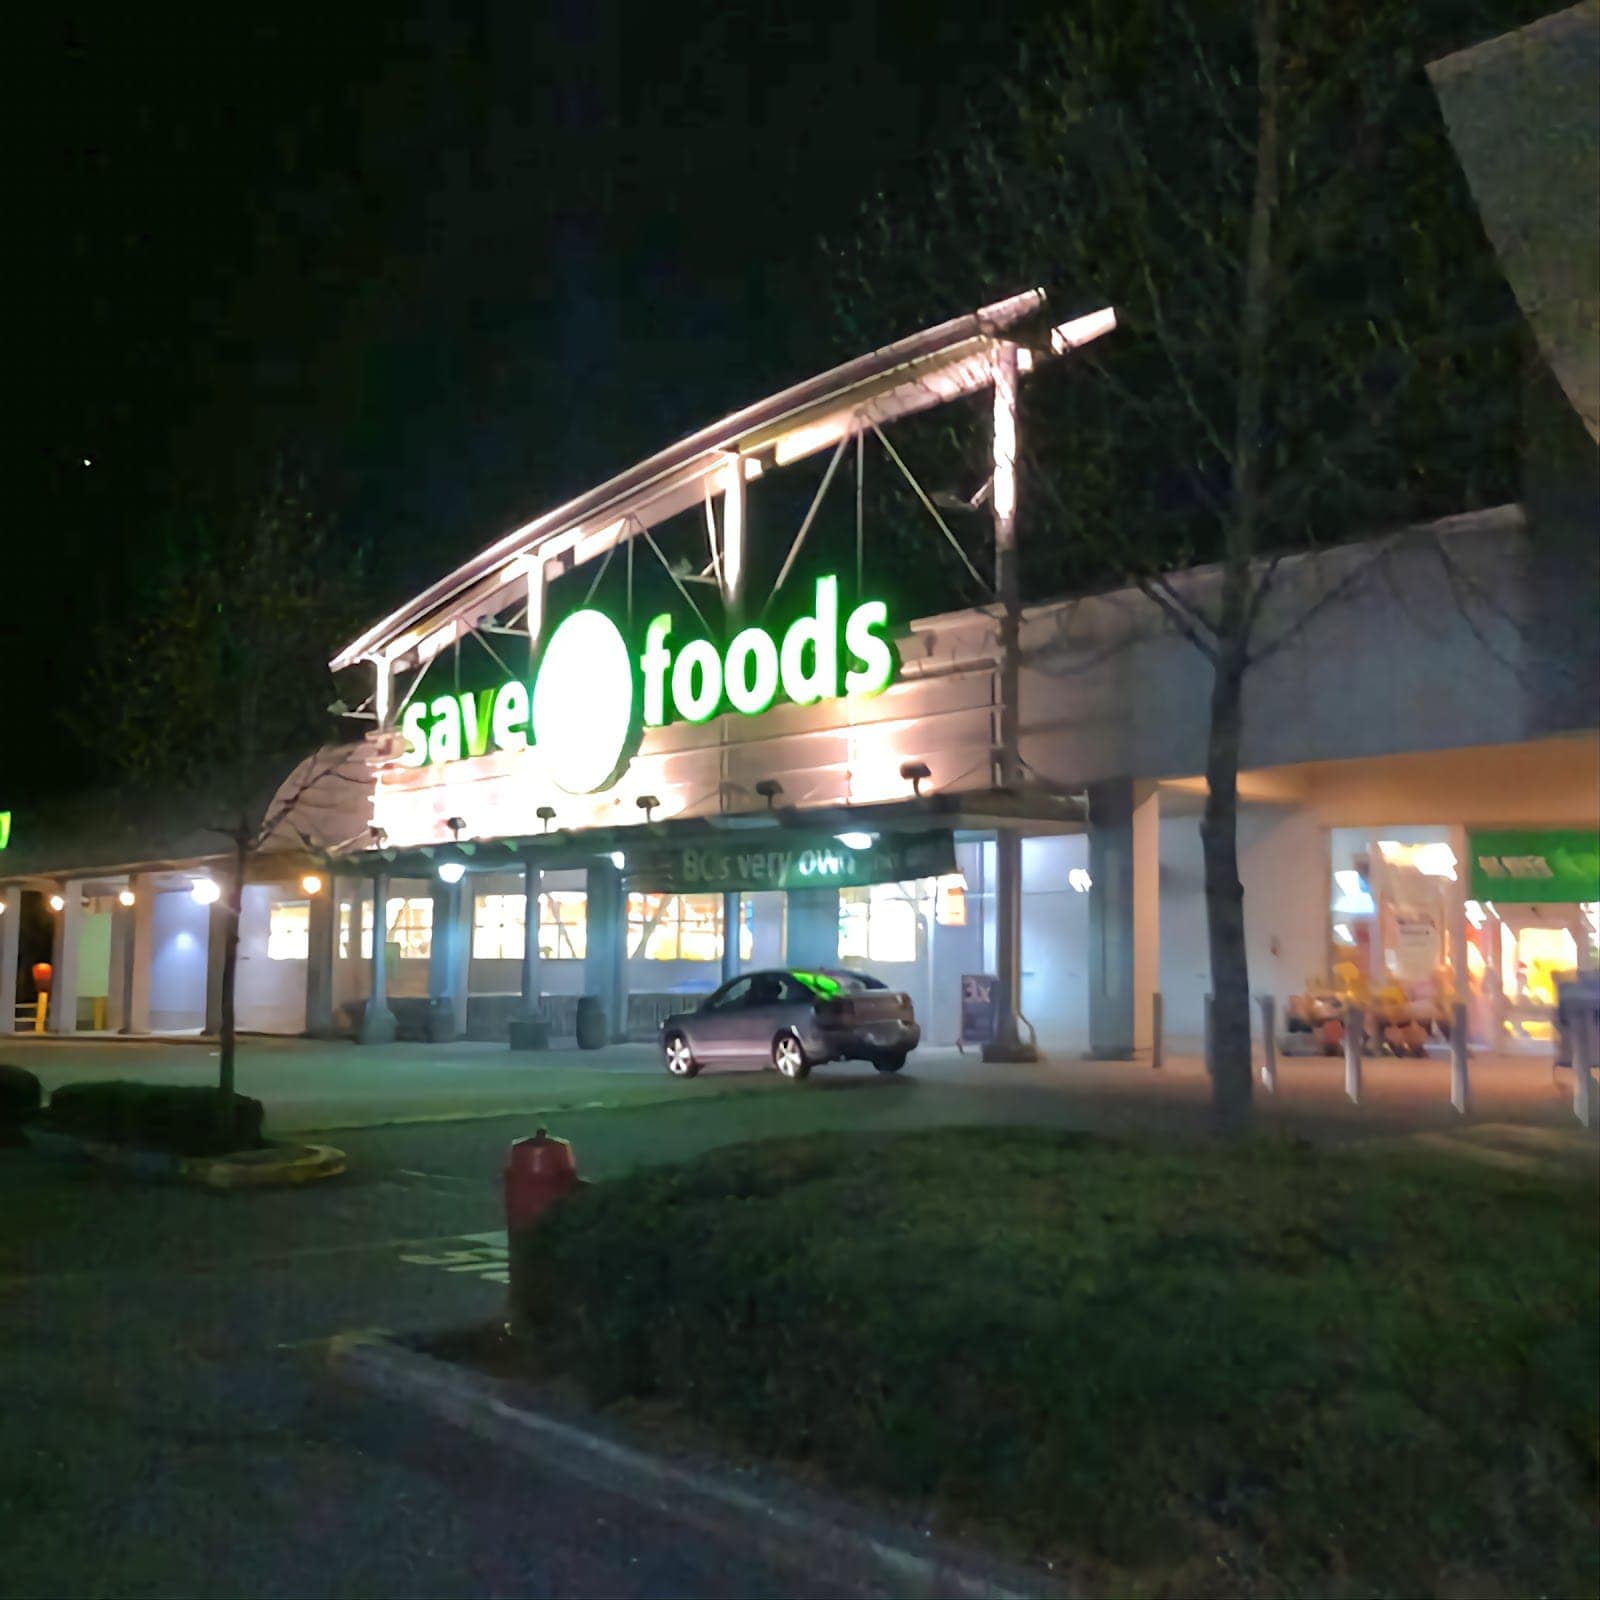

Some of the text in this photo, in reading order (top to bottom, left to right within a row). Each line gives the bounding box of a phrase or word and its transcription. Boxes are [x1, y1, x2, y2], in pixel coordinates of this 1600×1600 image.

[401, 575, 893, 767] save foods
[682, 849, 730, 882] BCs
[737, 848, 791, 887] very
[799, 846, 855, 876] own
